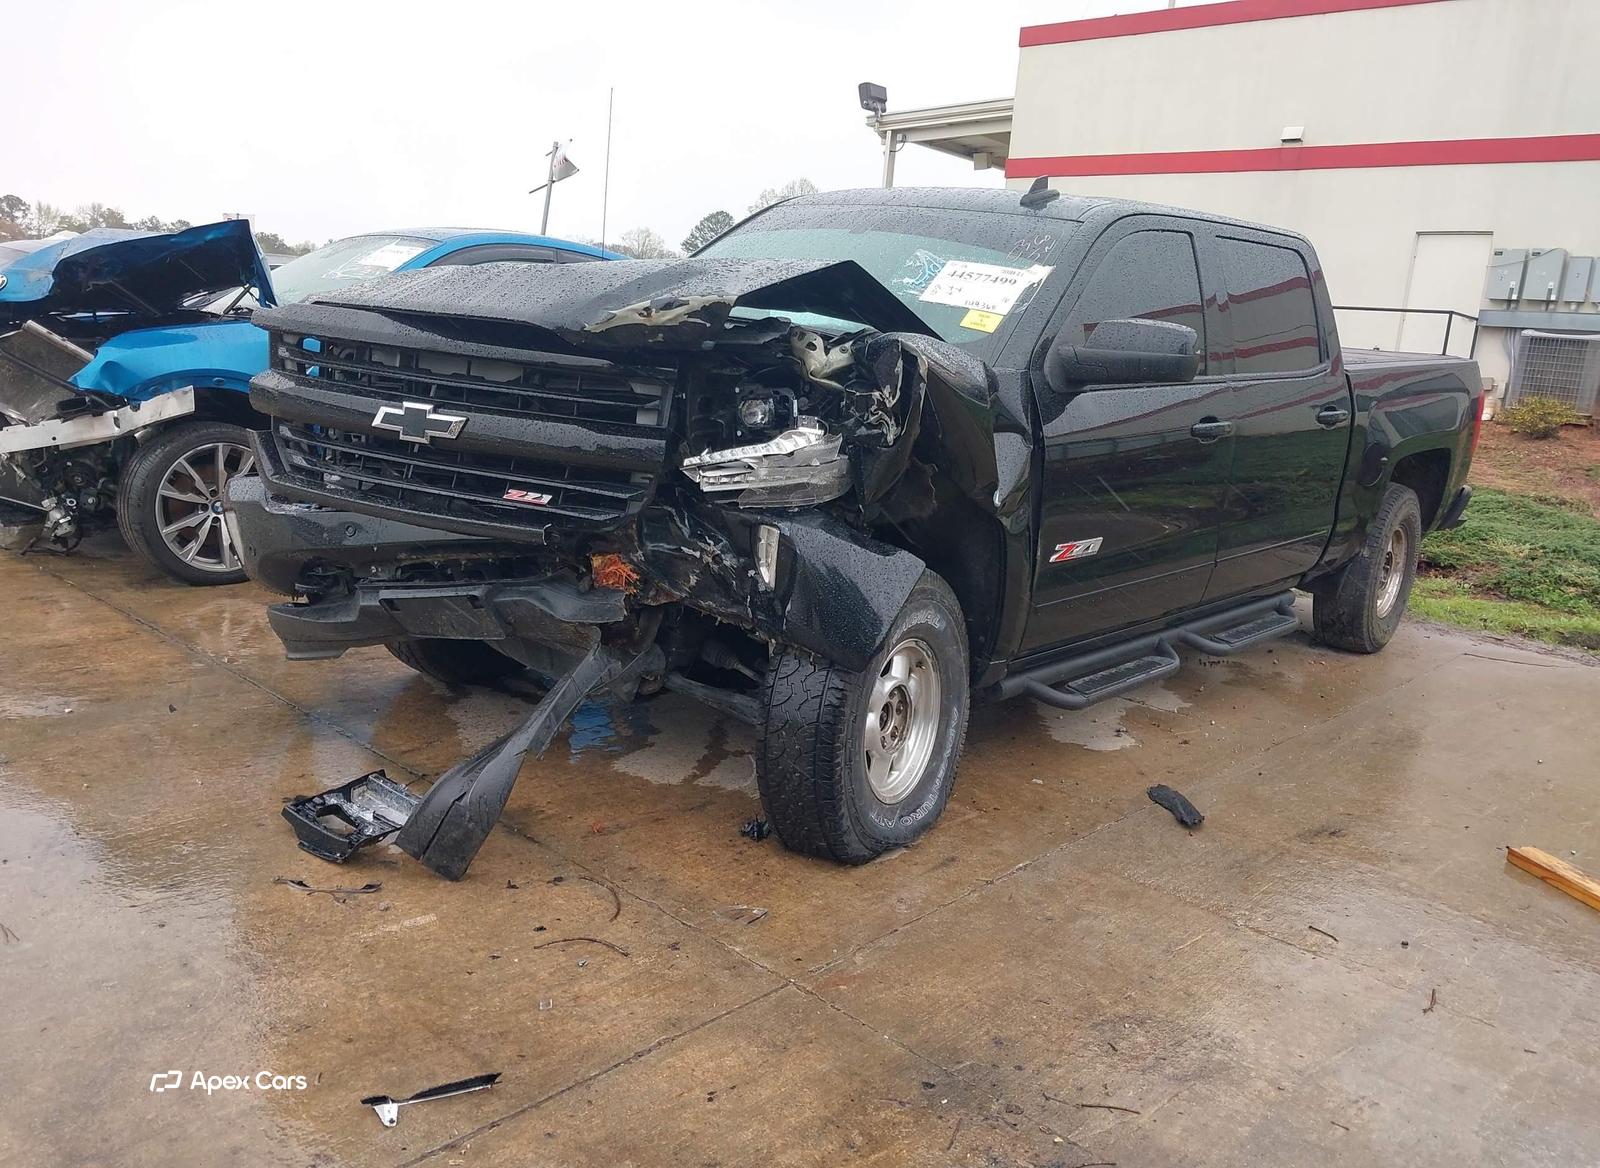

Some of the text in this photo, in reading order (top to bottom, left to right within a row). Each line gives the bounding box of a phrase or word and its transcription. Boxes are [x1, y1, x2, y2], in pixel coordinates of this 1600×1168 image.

[947, 270, 1018, 286] 44577499
[502, 488, 553, 506] Z71
[1048, 536, 1104, 563] Z71
